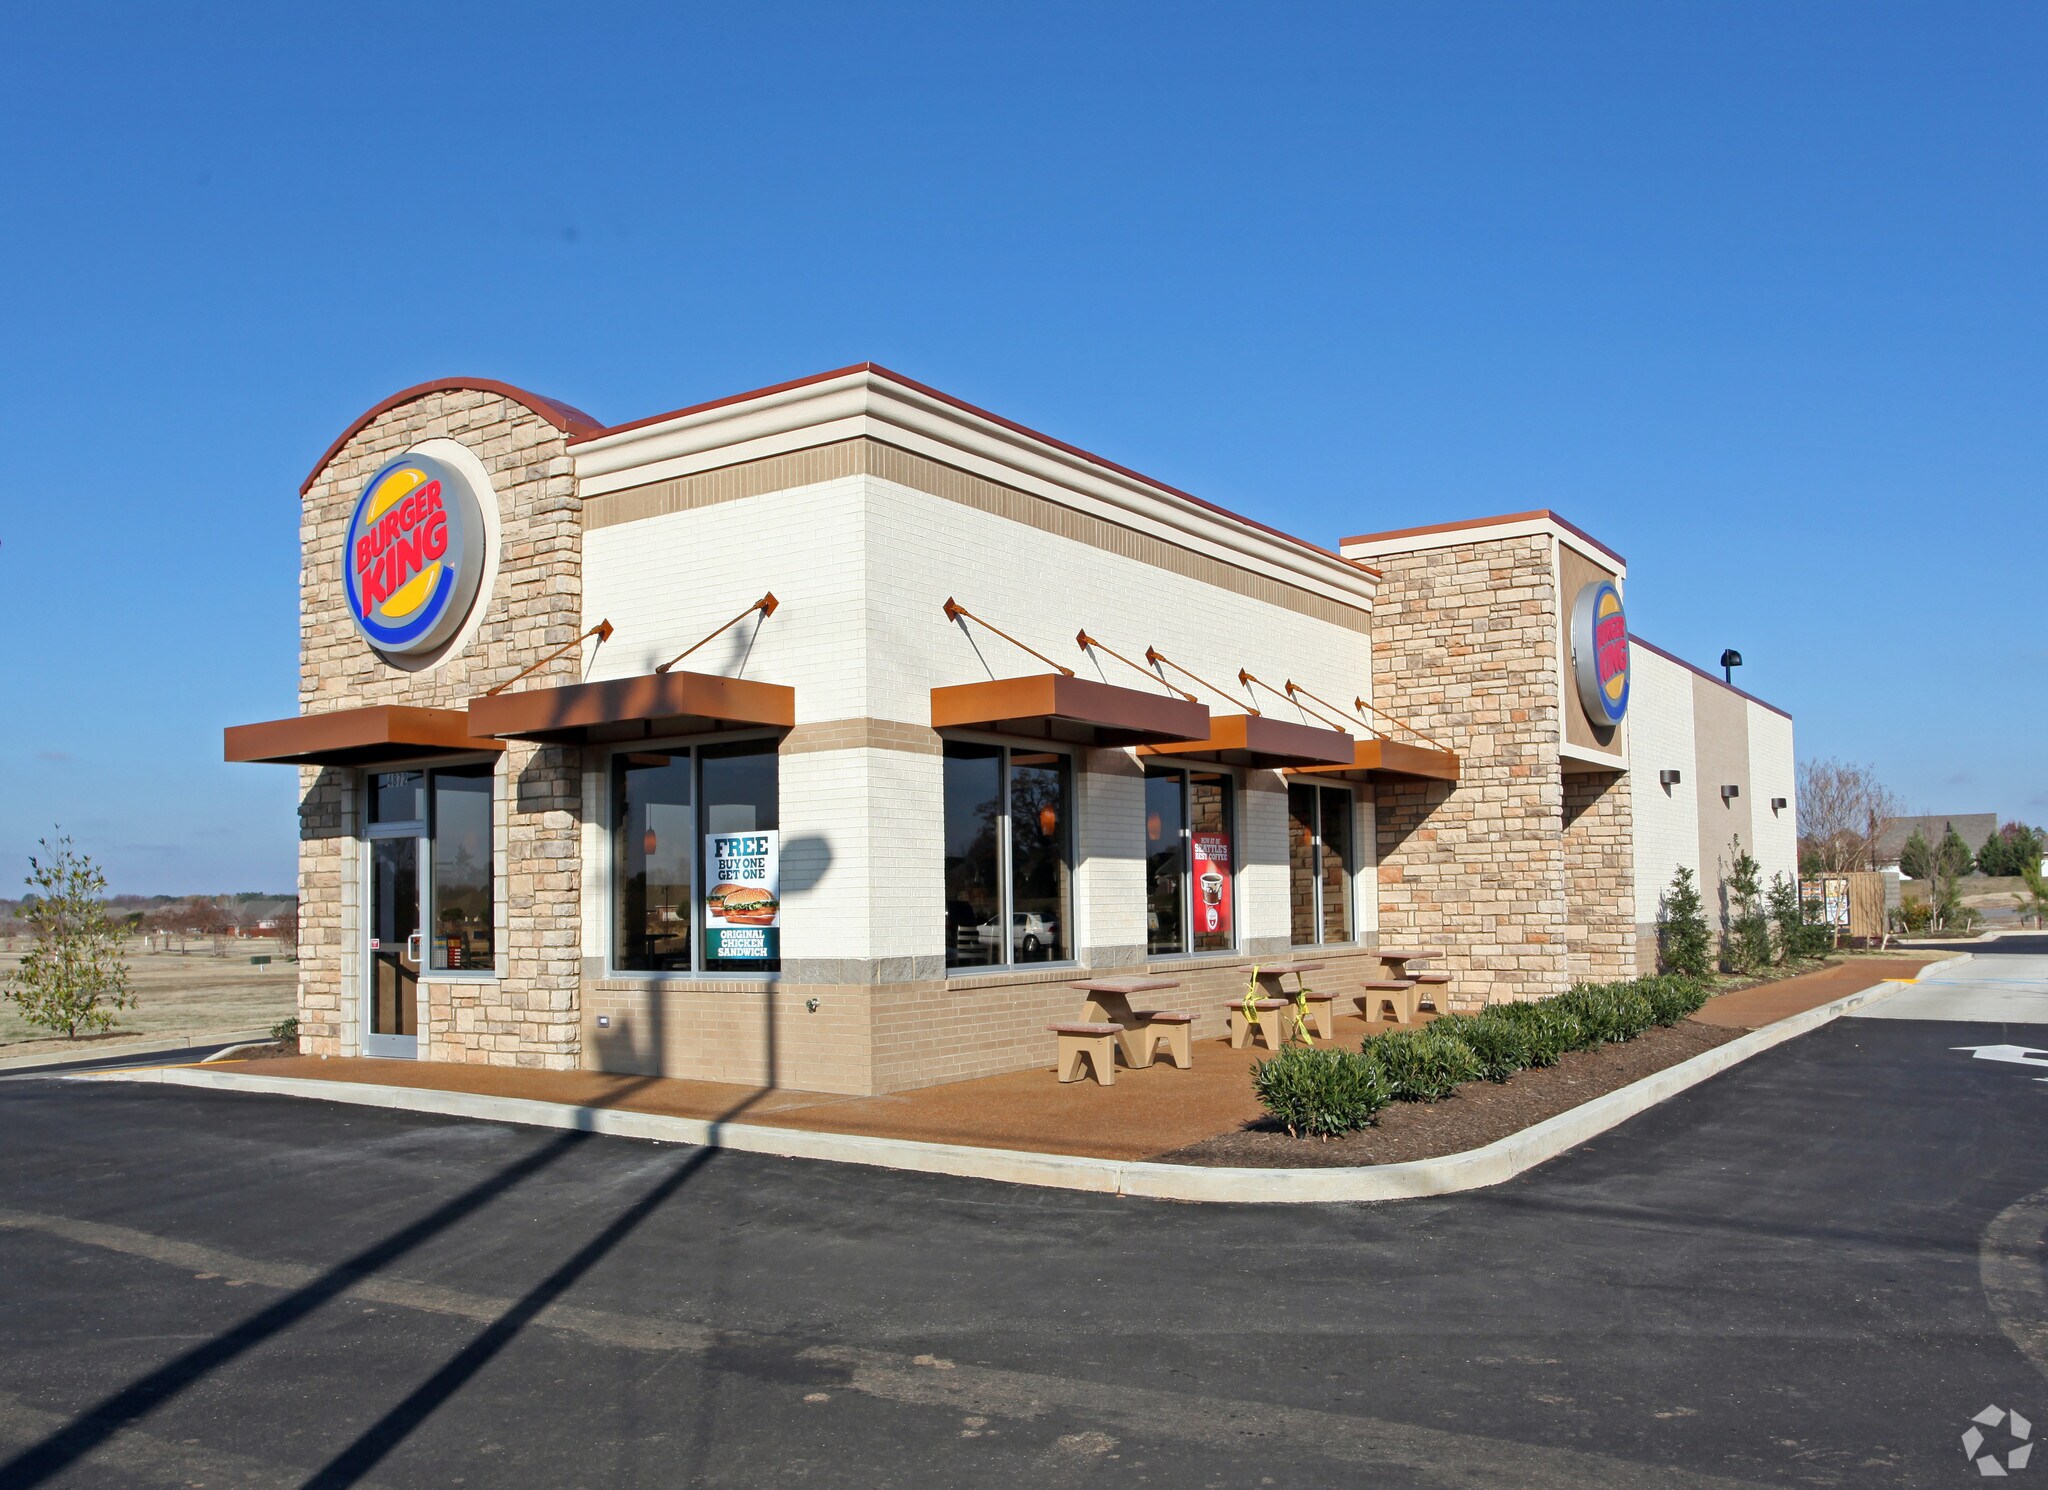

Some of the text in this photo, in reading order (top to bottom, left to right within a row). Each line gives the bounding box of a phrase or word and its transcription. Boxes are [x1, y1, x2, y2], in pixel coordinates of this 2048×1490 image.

[357, 479, 443, 574] BURGER
[361, 510, 448, 618] KING
[714, 836, 768, 857] FREE
[1194, 843, 1228, 853] SEATTLE'S
[719, 857, 765, 869] BUY ONE
[718, 868, 765, 880] GET ONE
[720, 929, 765, 939] ORIGINAL
[721, 938, 764, 948] CHICKEN
[717, 947, 768, 957] SANDWICH
